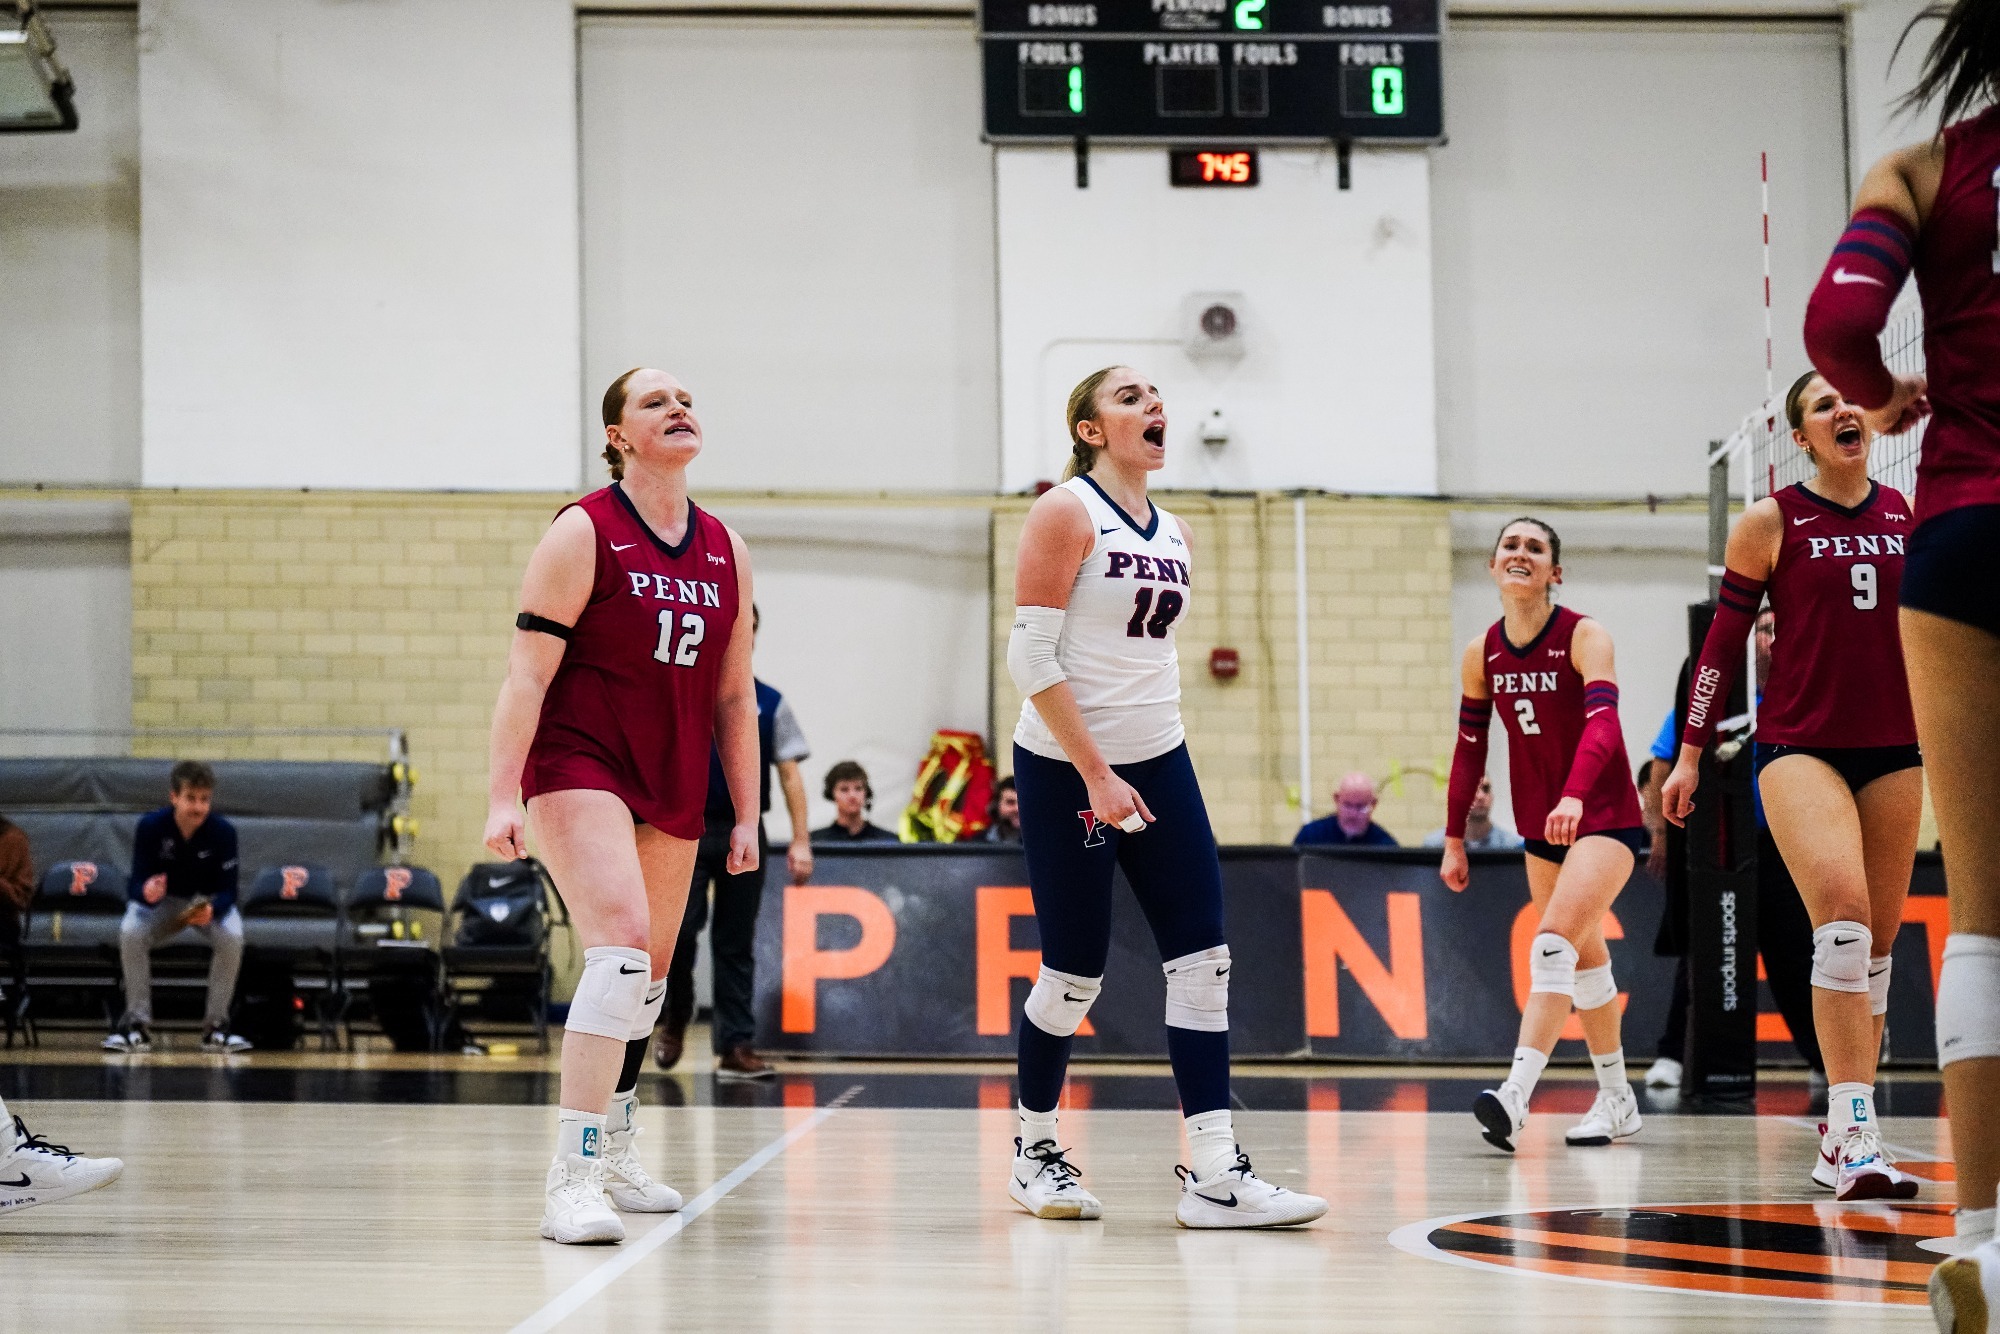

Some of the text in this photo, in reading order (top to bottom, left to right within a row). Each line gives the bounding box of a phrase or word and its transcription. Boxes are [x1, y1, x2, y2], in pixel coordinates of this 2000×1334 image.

[1028, 4, 1097, 26] BONUS
[1235, 0, 1266, 30] 2
[1323, 5, 1391, 27] BONUS
[1018, 42, 1083, 65] FOULS
[1144, 43, 1297, 65] PLAYER FOULS
[1340, 43, 1403, 65] FOULS
[1068, 66, 1083, 113] 1
[1371, 66, 1403, 114] 0
[1808, 534, 1905, 559] PENN
[628, 571, 720, 608] PENN
[1850, 563, 1878, 610] 9
[653, 608, 705, 667] 12
[1493, 671, 1558, 694] PENN
[1688, 665, 1720, 728] QUAKERS
[1514, 698, 1541, 735] 2
